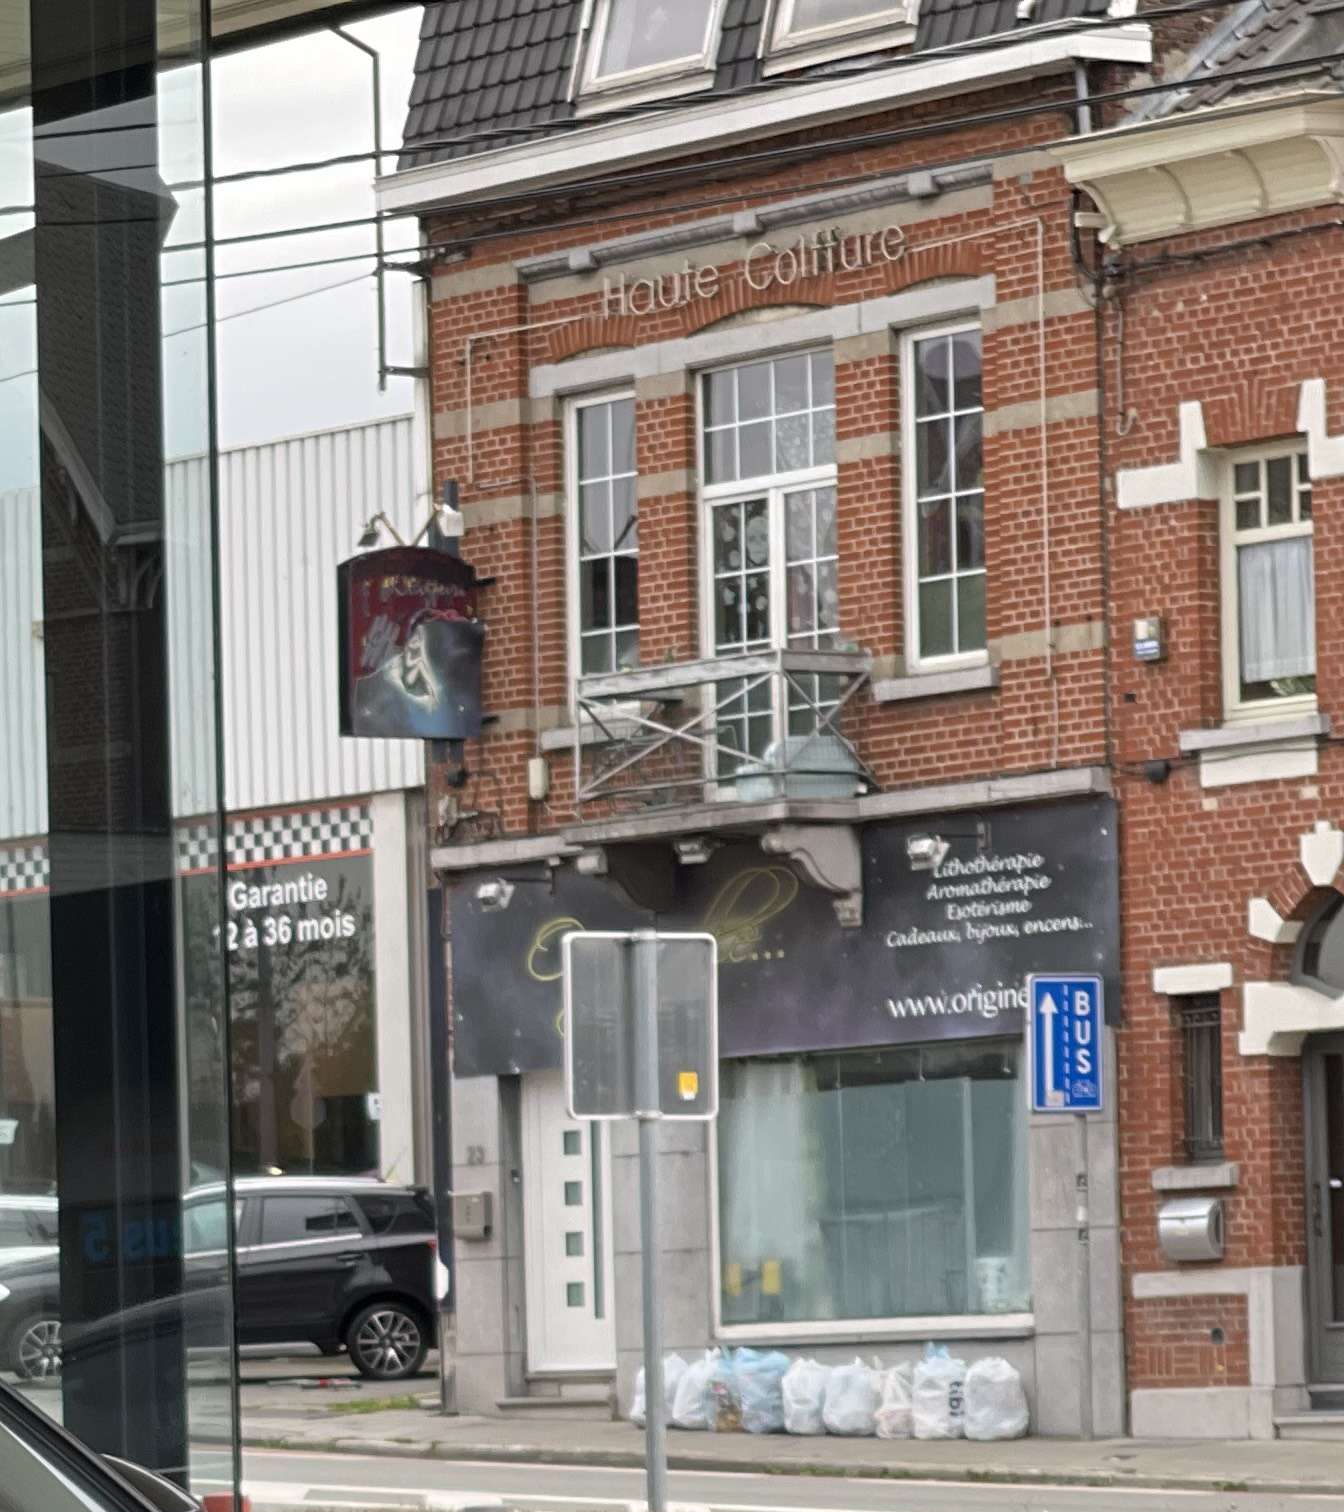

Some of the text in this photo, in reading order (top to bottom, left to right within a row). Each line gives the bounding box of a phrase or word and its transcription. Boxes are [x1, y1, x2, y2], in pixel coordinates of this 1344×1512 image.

[601, 225, 905, 320] Haute Coiffure
[230, 873, 328, 911] Garantie
[926, 873, 1053, 901] Aromathérapie
[244, 918, 259, 949] à
[263, 915, 292, 946] 36
[297, 909, 356, 943] mois
[1073, 990, 1093, 1075] BUS
